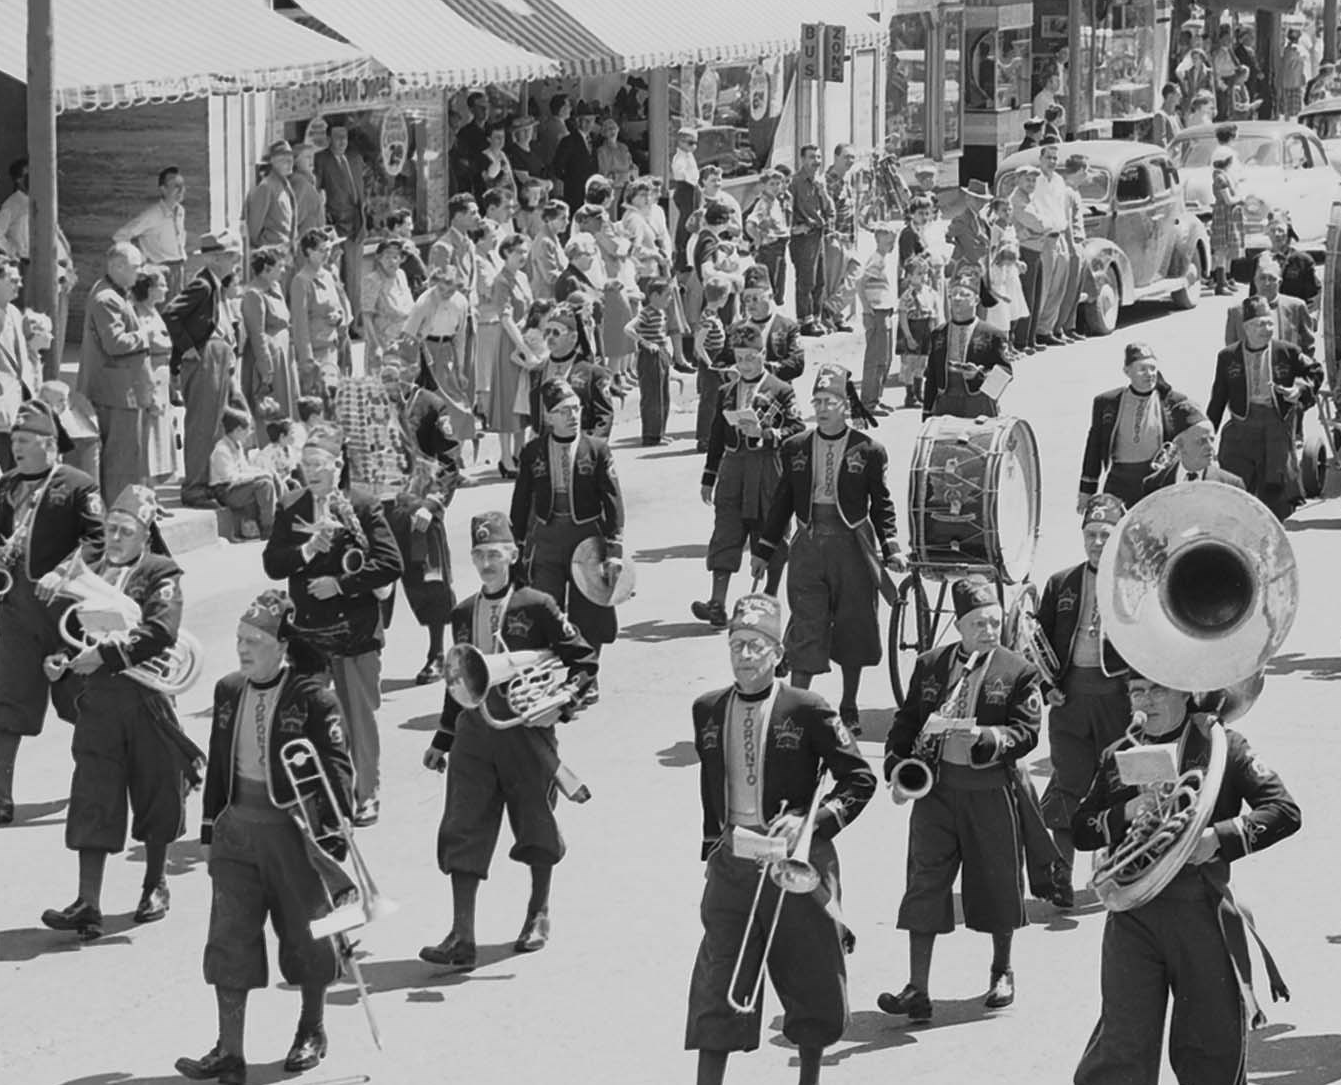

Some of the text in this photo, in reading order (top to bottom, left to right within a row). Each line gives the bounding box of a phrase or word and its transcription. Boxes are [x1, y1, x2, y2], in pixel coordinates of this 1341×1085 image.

[805, 25, 815, 77] BUS
[831, 26, 842, 80] ZONE
[825, 443, 835, 496] TORONTO
[744, 705, 757, 786] TORONTO
